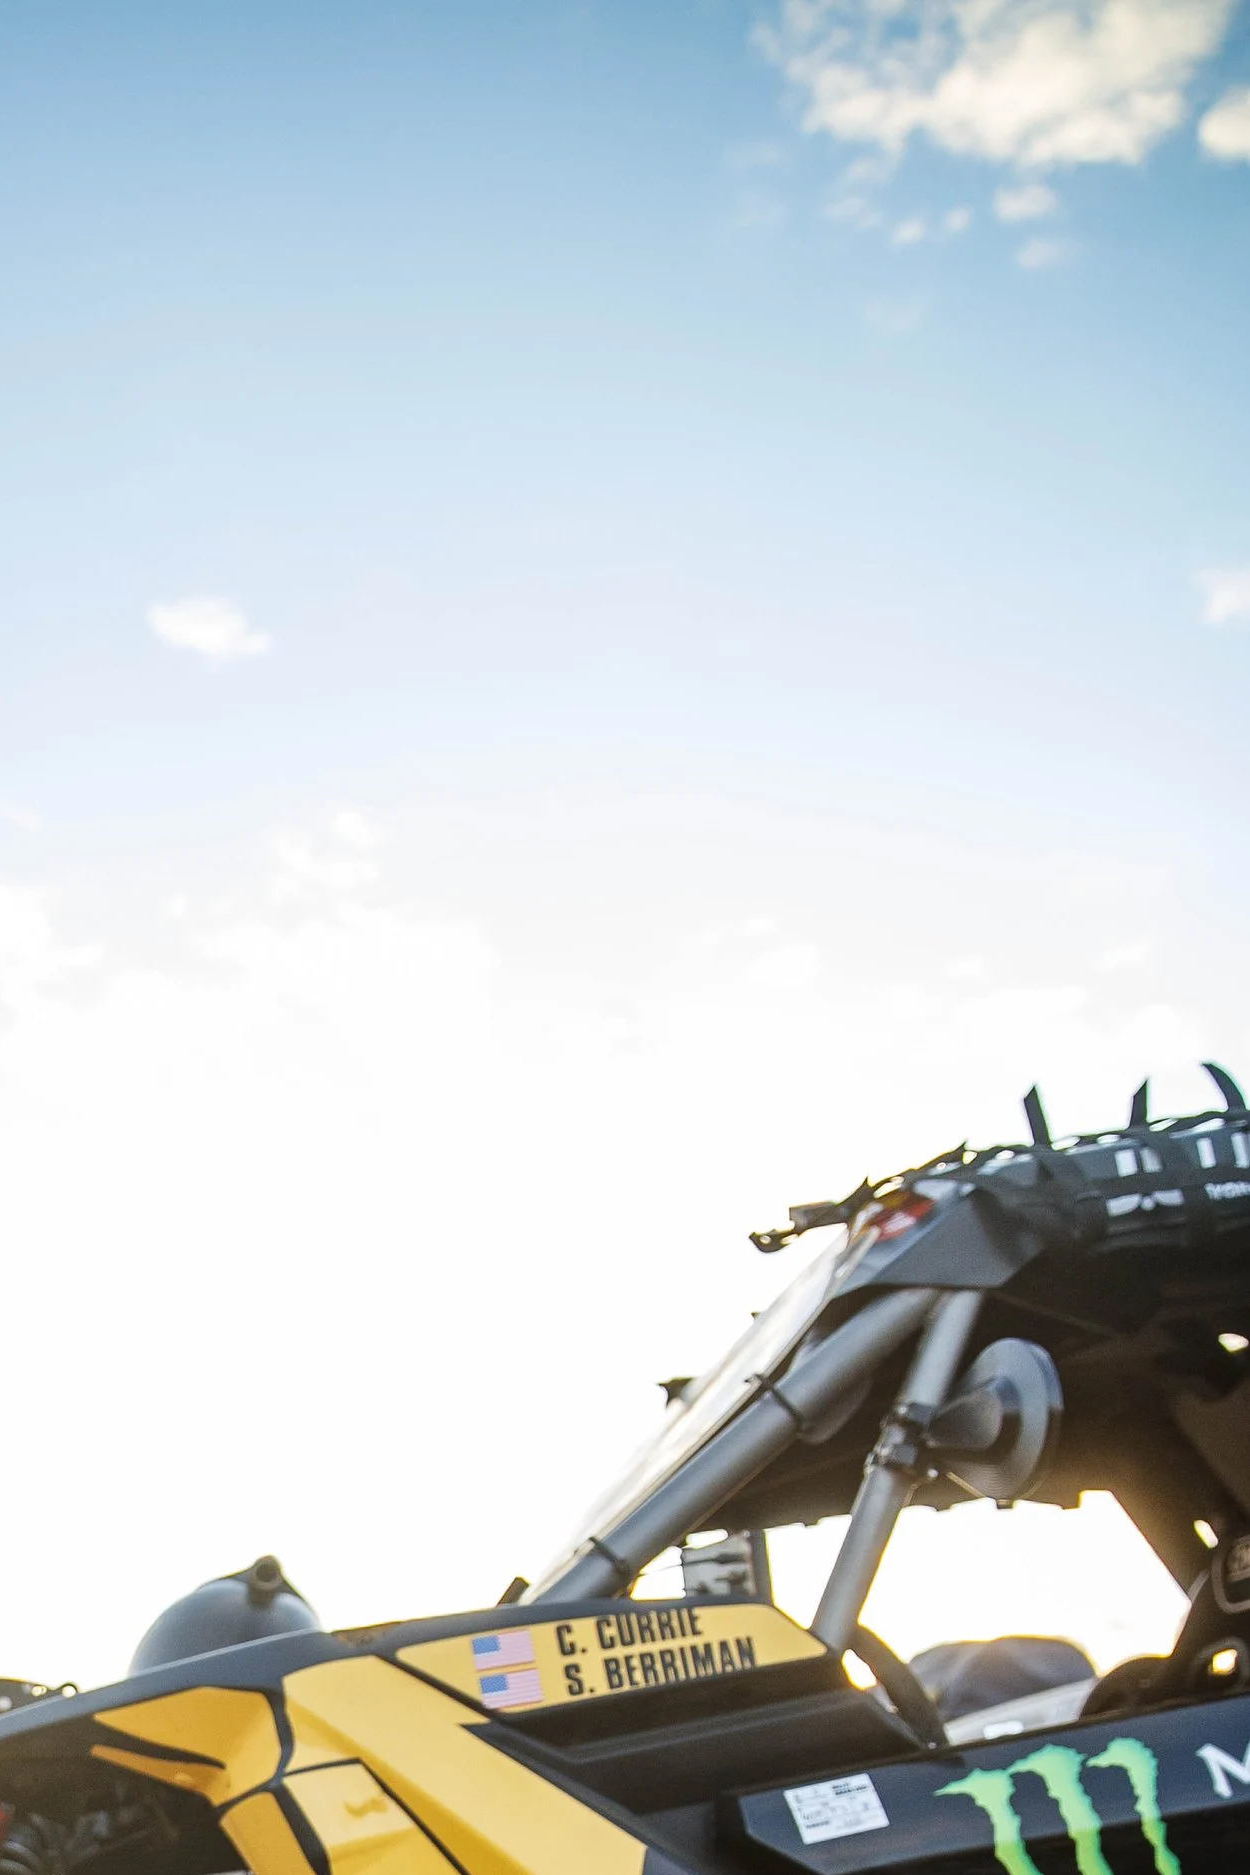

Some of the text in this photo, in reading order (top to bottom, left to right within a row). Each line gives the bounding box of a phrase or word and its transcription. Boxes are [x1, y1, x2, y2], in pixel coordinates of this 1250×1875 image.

[555, 1606, 703, 1656] C. CURRIE
[563, 1636, 755, 1697] S. BERRIMAN
